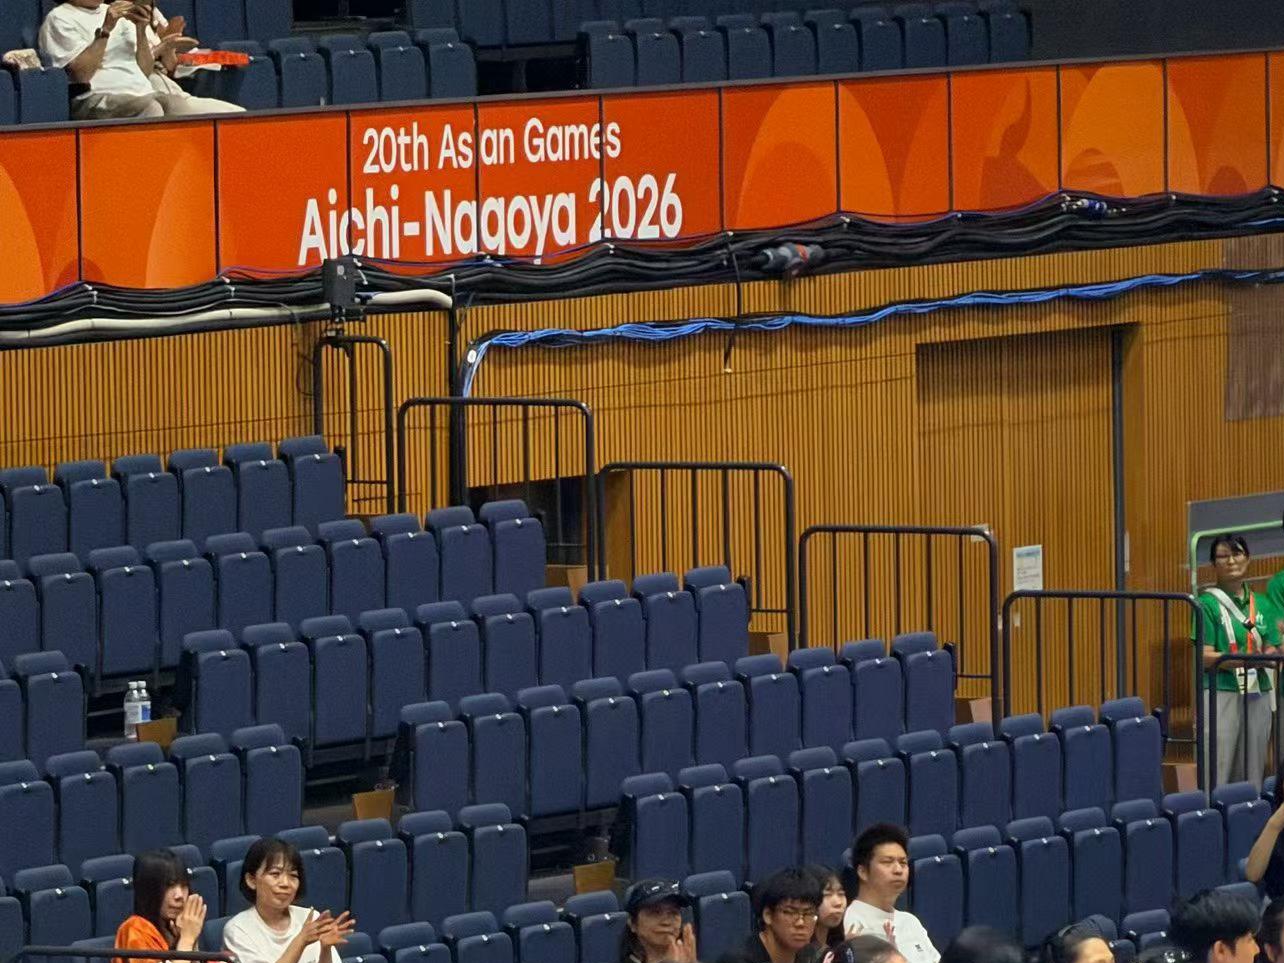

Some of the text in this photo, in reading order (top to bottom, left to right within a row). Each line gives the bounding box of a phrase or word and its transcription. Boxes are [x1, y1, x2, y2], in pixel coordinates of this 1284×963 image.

[363, 117, 621, 173] 20th Asan Games
[298, 173, 683, 265] Aichi-Nagoya 2026
